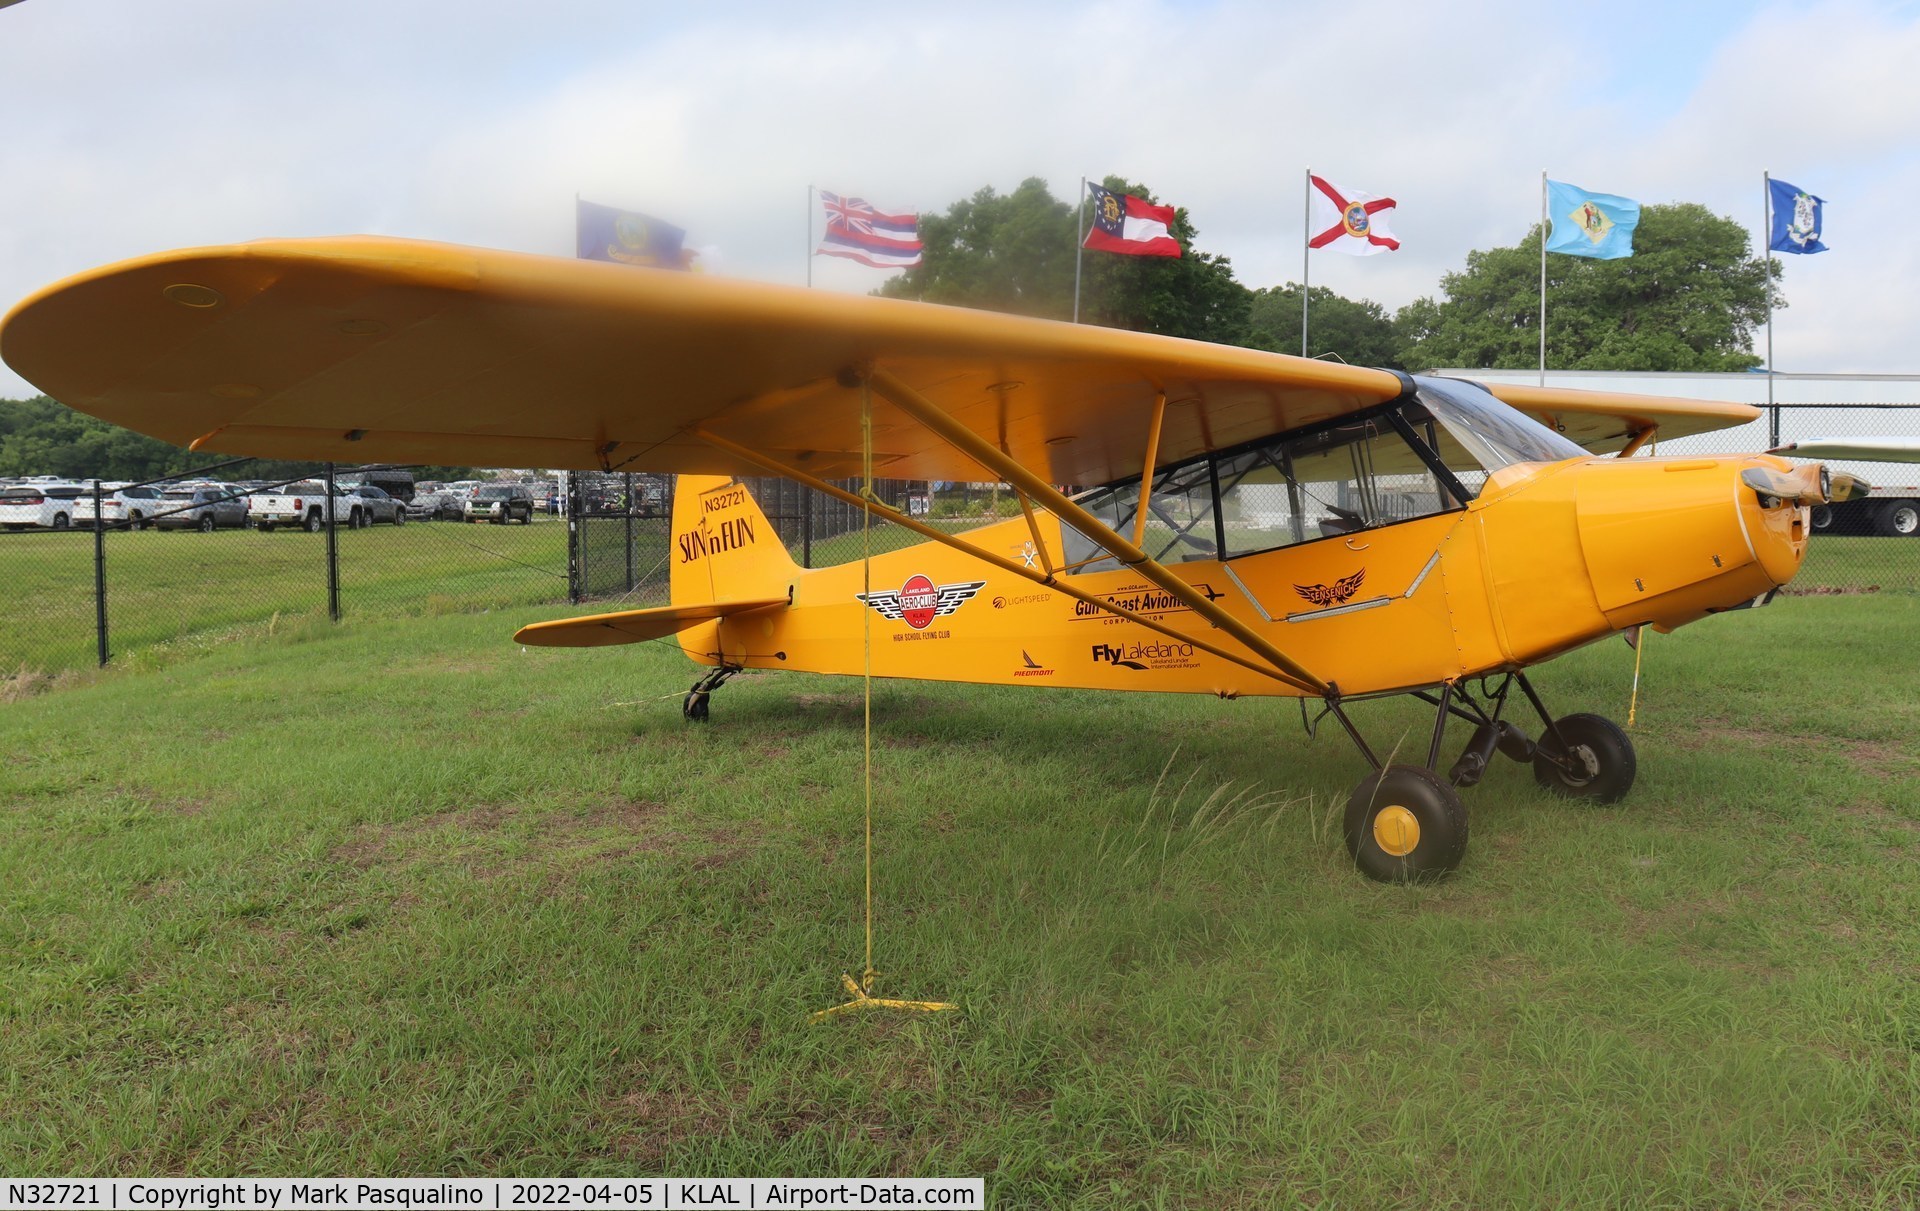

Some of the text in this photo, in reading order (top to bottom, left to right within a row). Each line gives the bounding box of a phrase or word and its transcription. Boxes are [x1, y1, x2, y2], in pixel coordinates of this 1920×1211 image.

[705, 490, 745, 513] N32721
[679, 528, 707, 564] SUN
[721, 515, 755, 552] FUN
[905, 587, 930, 595] LAKELAND
[1310, 583, 1355, 602] SENSENICH
[900, 595, 937, 609] AERO-CLUB
[1103, 615, 1164, 625] CORPOION
[893, 630, 950, 642] HIGH SCHOOL FLYING CLUB
[1014, 669, 1055, 677] PIEDMONT
